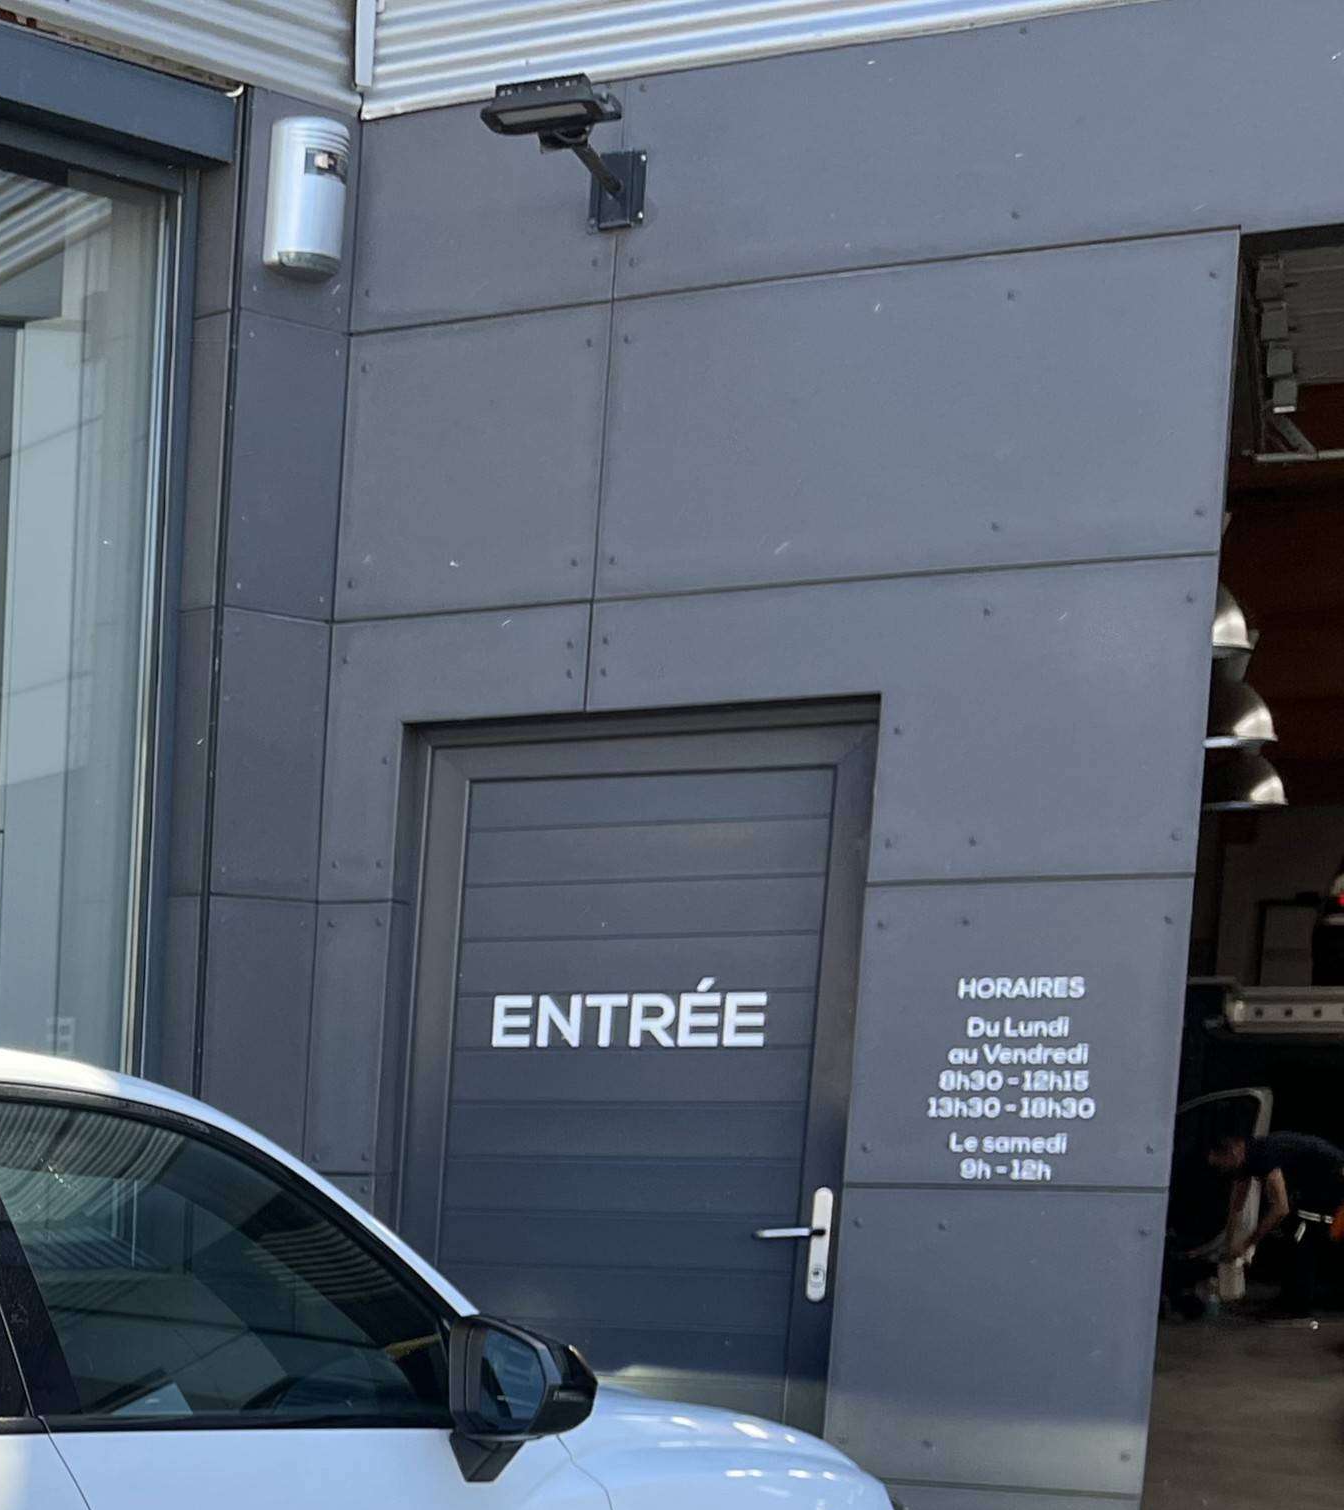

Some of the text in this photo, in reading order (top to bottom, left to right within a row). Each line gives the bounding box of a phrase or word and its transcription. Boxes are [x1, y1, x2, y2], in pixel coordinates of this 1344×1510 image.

[957, 975, 1086, 1000] HORAIRES
[491, 977, 768, 1048] ENTRÉE
[967, 1016, 1070, 1038] Du Lundi
[948, 1043, 1089, 1065] au Vendredi
[938, 1069, 1004, 1091] 8h30
[1022, 1069, 1089, 1092] 12h15
[927, 1097, 1002, 1119] 13h30
[1019, 1097, 1096, 1119] 18h30
[949, 1132, 1067, 1154] Le samedi
[960, 1158, 991, 1180] 9h
[1010, 1159, 1052, 1181] 12h
